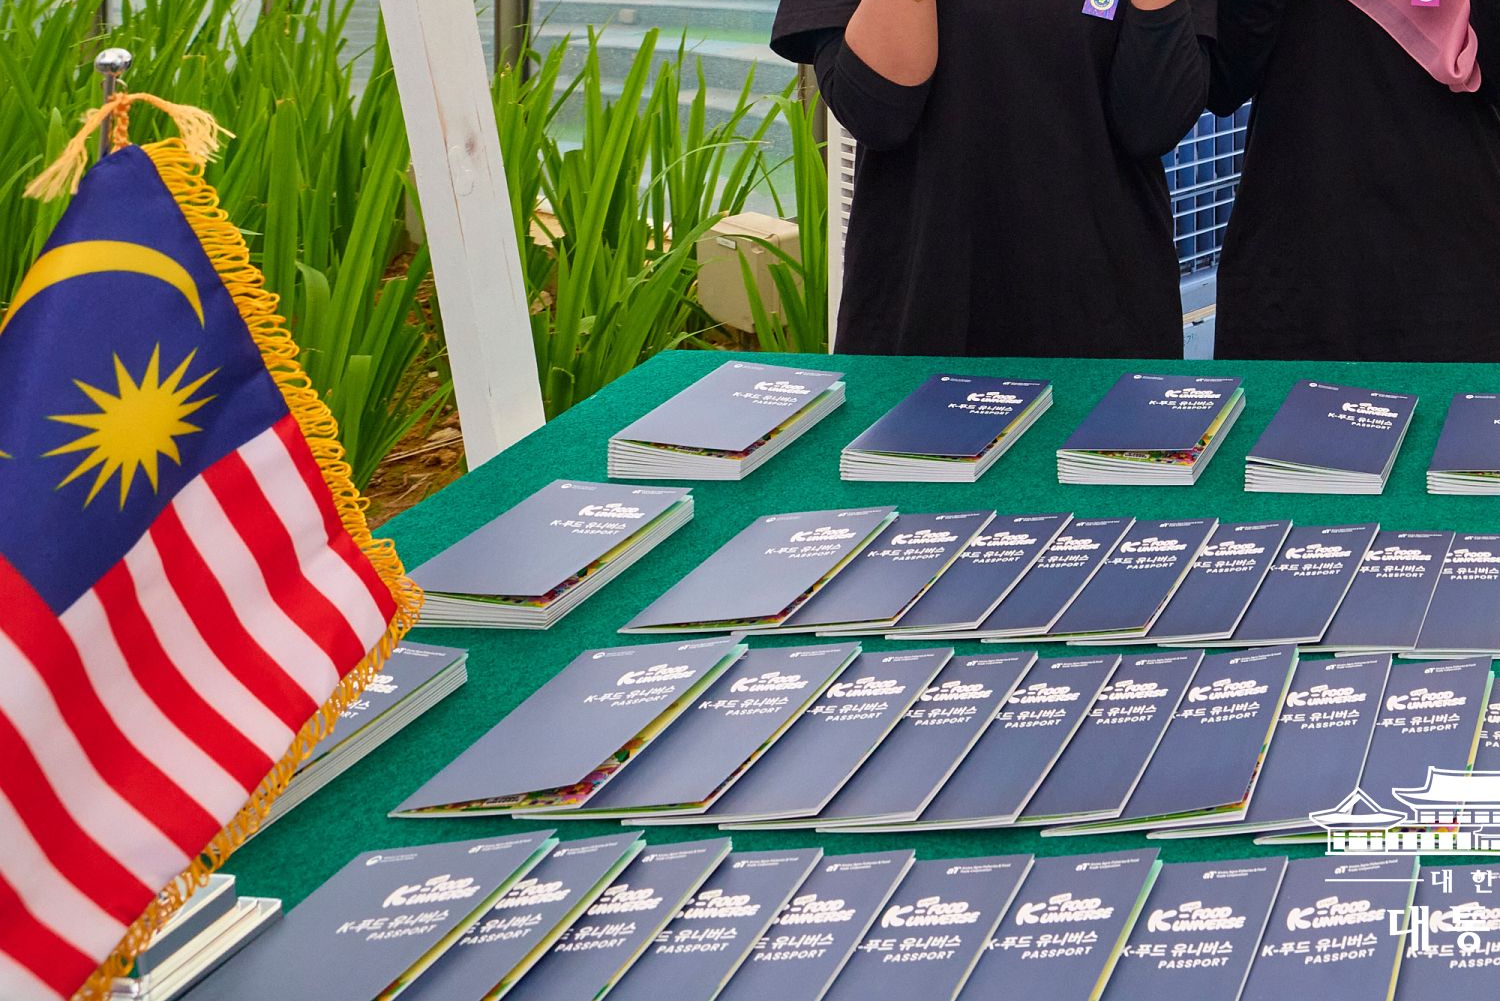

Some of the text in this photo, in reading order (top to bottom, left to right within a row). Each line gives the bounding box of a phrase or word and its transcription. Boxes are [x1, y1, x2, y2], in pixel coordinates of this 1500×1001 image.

[968, 408, 1010, 416] PASSPORT
[1351, 421, 1392, 430] PASSPORT
[788, 550, 837, 558] PASSPORT
[892, 554, 941, 562] PASSPORT
[972, 556, 1021, 564] PASSPORT
[1037, 562, 1085, 570] PASSPORT
[1126, 562, 1174, 570] PASSPORT
[1206, 566, 1254, 574] PASSPORT
[1302, 562, 1344, 571] 유니버스
[1208, 685, 1268, 700] UNIVERSE
[610, 694, 669, 708] PASSPORT
[741, 696, 790, 707] 유니버스
[1307, 693, 1367, 706] UNIVERSE
[1406, 696, 1467, 710] UNIVERSE
[725, 706, 782, 716] PASSPORT
[1107, 704, 1158, 716] 유니버스
[1210, 701, 1261, 716] 유니버스
[825, 712, 882, 723] PASSPORT
[914, 716, 972, 726] PASSPORT
[1096, 715, 1154, 725] PASSPORT
[1200, 711, 1258, 724] PASSPORT
[1309, 709, 1360, 722] 유니버스
[1410, 713, 1461, 726] 유니버스
[1004, 718, 1062, 728] PASSPORT
[1300, 719, 1358, 730] PASSPORT
[1402, 723, 1459, 734] PASSPORT
[587, 897, 664, 916] UNIVERSE
[684, 904, 762, 920] UNIVERSE
[388, 909, 450, 928] 유니버스
[906, 911, 981, 928] UNIVERSE
[1039, 907, 1115, 924] UNIVERSE
[1312, 909, 1387, 929] UNIVERSE
[1172, 916, 1247, 932] UNIVERSE
[365, 924, 438, 942] PASSPORT
[460, 928, 532, 946] PASSPORT
[674, 926, 738, 942] 유니버스
[1036, 930, 1099, 946] 유니버스
[554, 938, 628, 952] PASSPORT
[656, 942, 730, 954] PASSPORT
[898, 934, 962, 951] 유니버스
[1170, 940, 1234, 957] 유니버스
[1261, 932, 1378, 958] K-푸드 유니버스
[754, 948, 827, 962] PASSPORT
[882, 950, 956, 963] PASSPORT
[1021, 946, 1093, 960] PASSPORT
[1304, 948, 1376, 965] PASSPORT
[1158, 956, 1230, 969] PASSPORT
